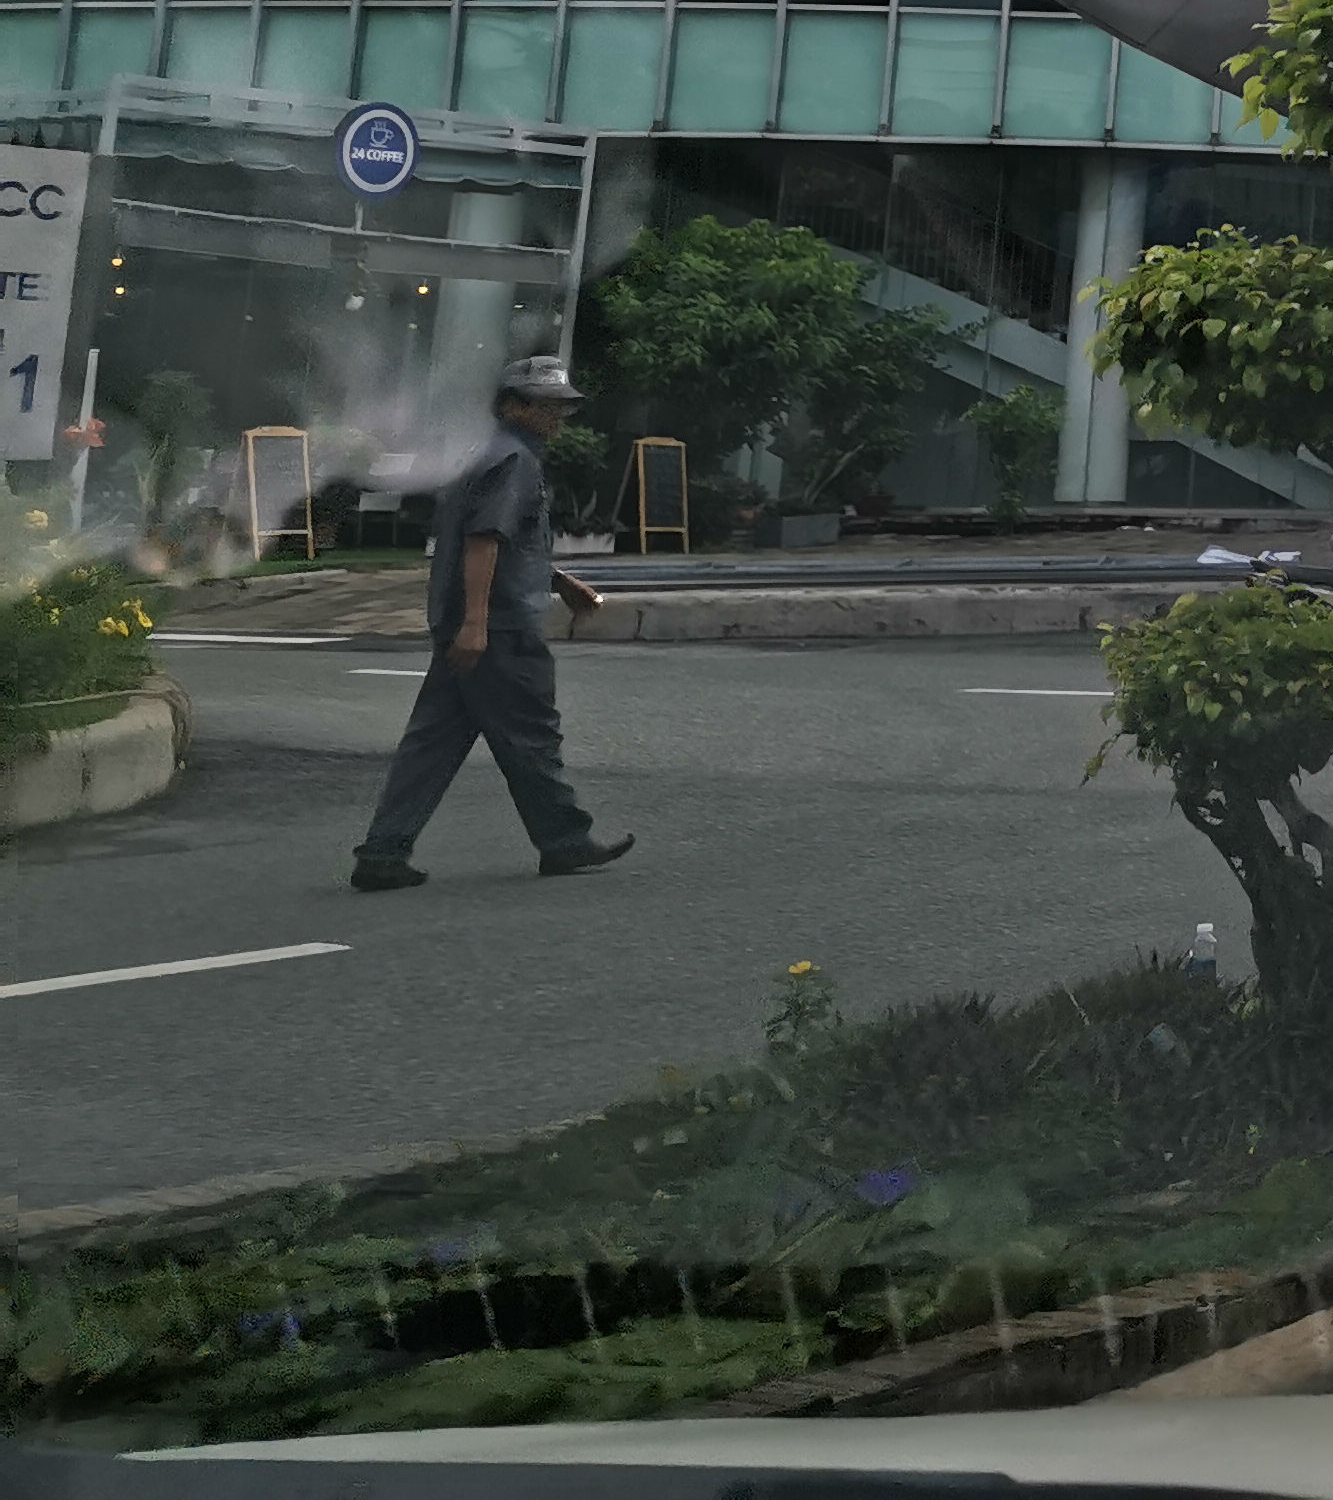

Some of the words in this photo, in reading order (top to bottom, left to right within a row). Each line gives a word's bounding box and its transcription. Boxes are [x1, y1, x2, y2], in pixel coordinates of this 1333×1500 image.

[351, 147, 365, 160] 24
[366, 148, 405, 164] COFFEE
[9, 354, 40, 414] 1
